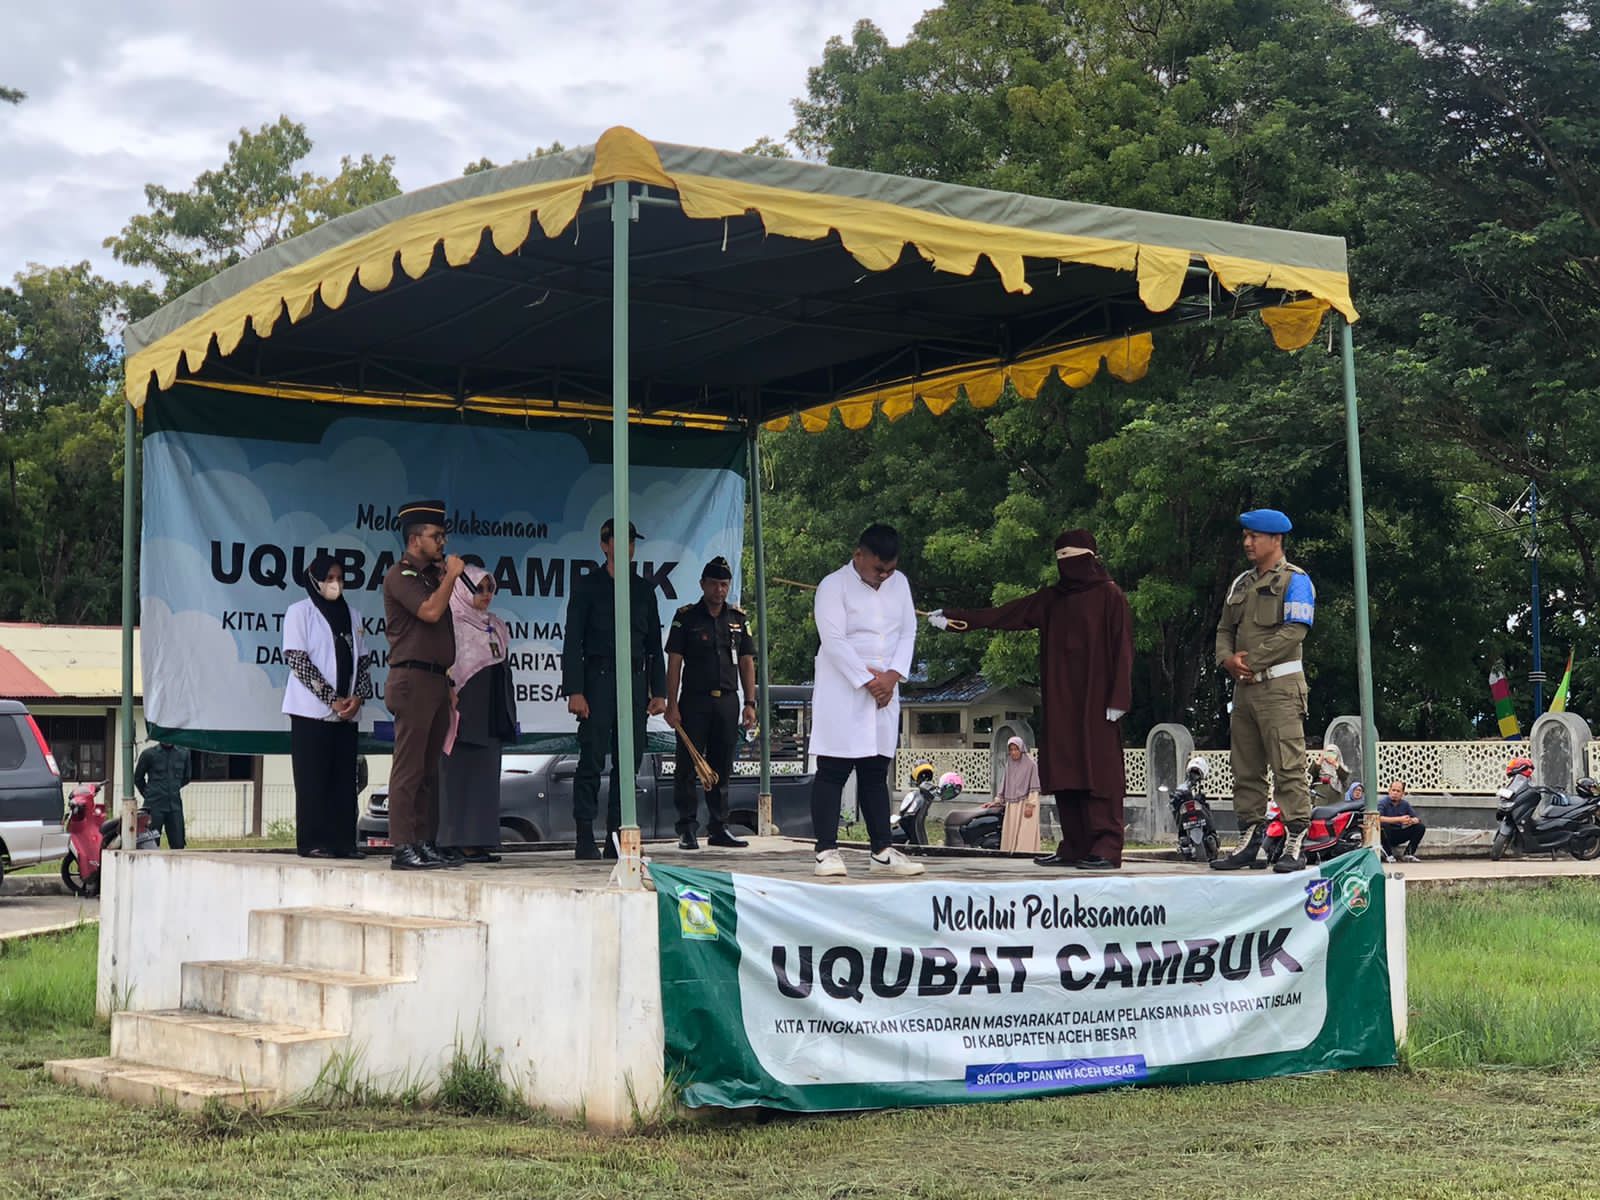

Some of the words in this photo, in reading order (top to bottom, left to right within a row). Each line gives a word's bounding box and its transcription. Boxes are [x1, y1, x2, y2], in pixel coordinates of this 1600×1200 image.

[356, 503, 401, 532] Mela
[445, 510, 548, 538] elaksanaan
[222, 611, 268, 632] KITA
[516, 684, 568, 701] BESA
[932, 895, 1016, 931] Melalui
[1022, 894, 1167, 929] Pelaksanaan
[771, 945, 1034, 1003] UQUBAT
[1055, 927, 1304, 992] CAMBUK
[775, 1019, 805, 1034] KITA
[808, 1018, 898, 1035] TINGKATKAN
[900, 1015, 981, 1033] KESADARAN
[983, 1011, 1073, 1030] MASYARAKAT
[1072, 1008, 1116, 1026] DALAM
[1118, 1002, 1211, 1022] PELAKSANAAN
[1213, 996, 1271, 1016] SYARI'AT
[1271, 991, 1302, 1009] ISLAM
[962, 1035, 977, 1049] DI
[978, 1031, 1055, 1048] KABUPATEN
[1058, 1028, 1092, 1045] ACEH
[1095, 1026, 1137, 1042] BESAR
[976, 1071, 1017, 1086] SATPOL
[1017, 1070, 1031, 1084] PP
[1032, 1069, 1054, 1082] DAN
[1055, 1067, 1072, 1080] WH
[1074, 1065, 1101, 1079] ACEH
[1102, 1063, 1136, 1077] BESAR
